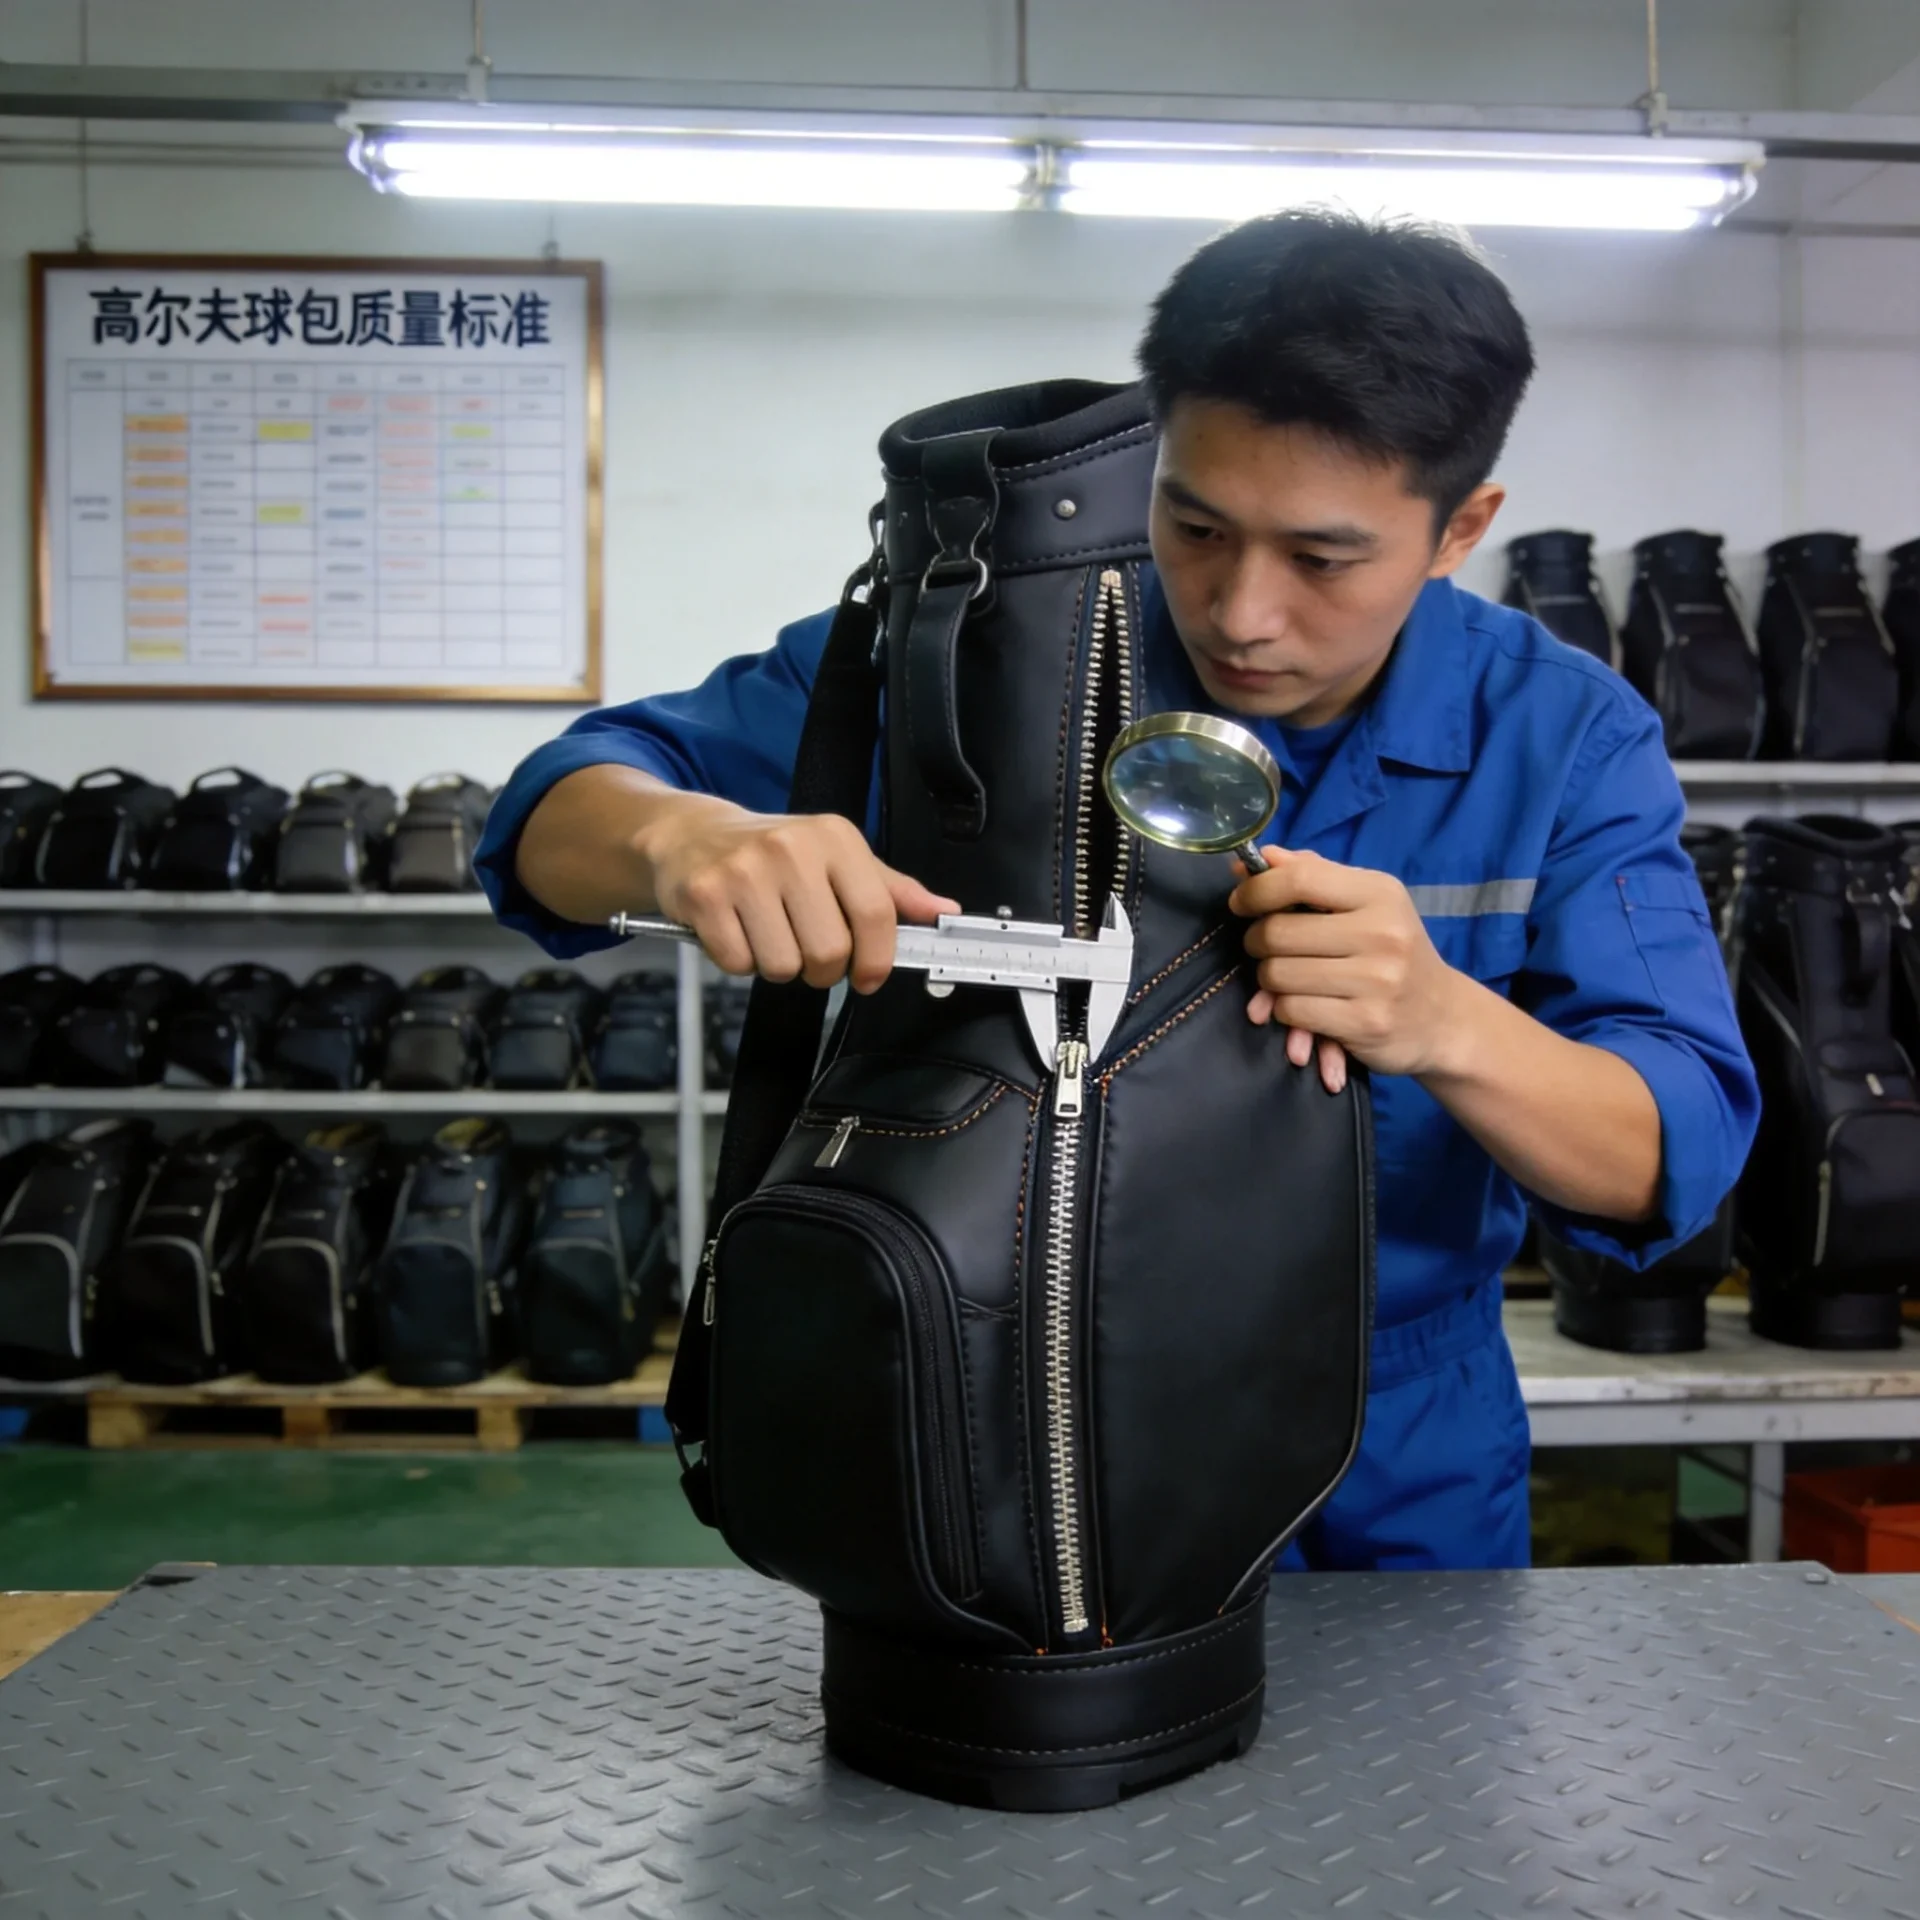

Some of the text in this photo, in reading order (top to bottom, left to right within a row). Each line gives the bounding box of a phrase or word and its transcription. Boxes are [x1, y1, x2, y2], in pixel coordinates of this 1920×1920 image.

[88, 286, 552, 348] 高尔夫球包质量标准
